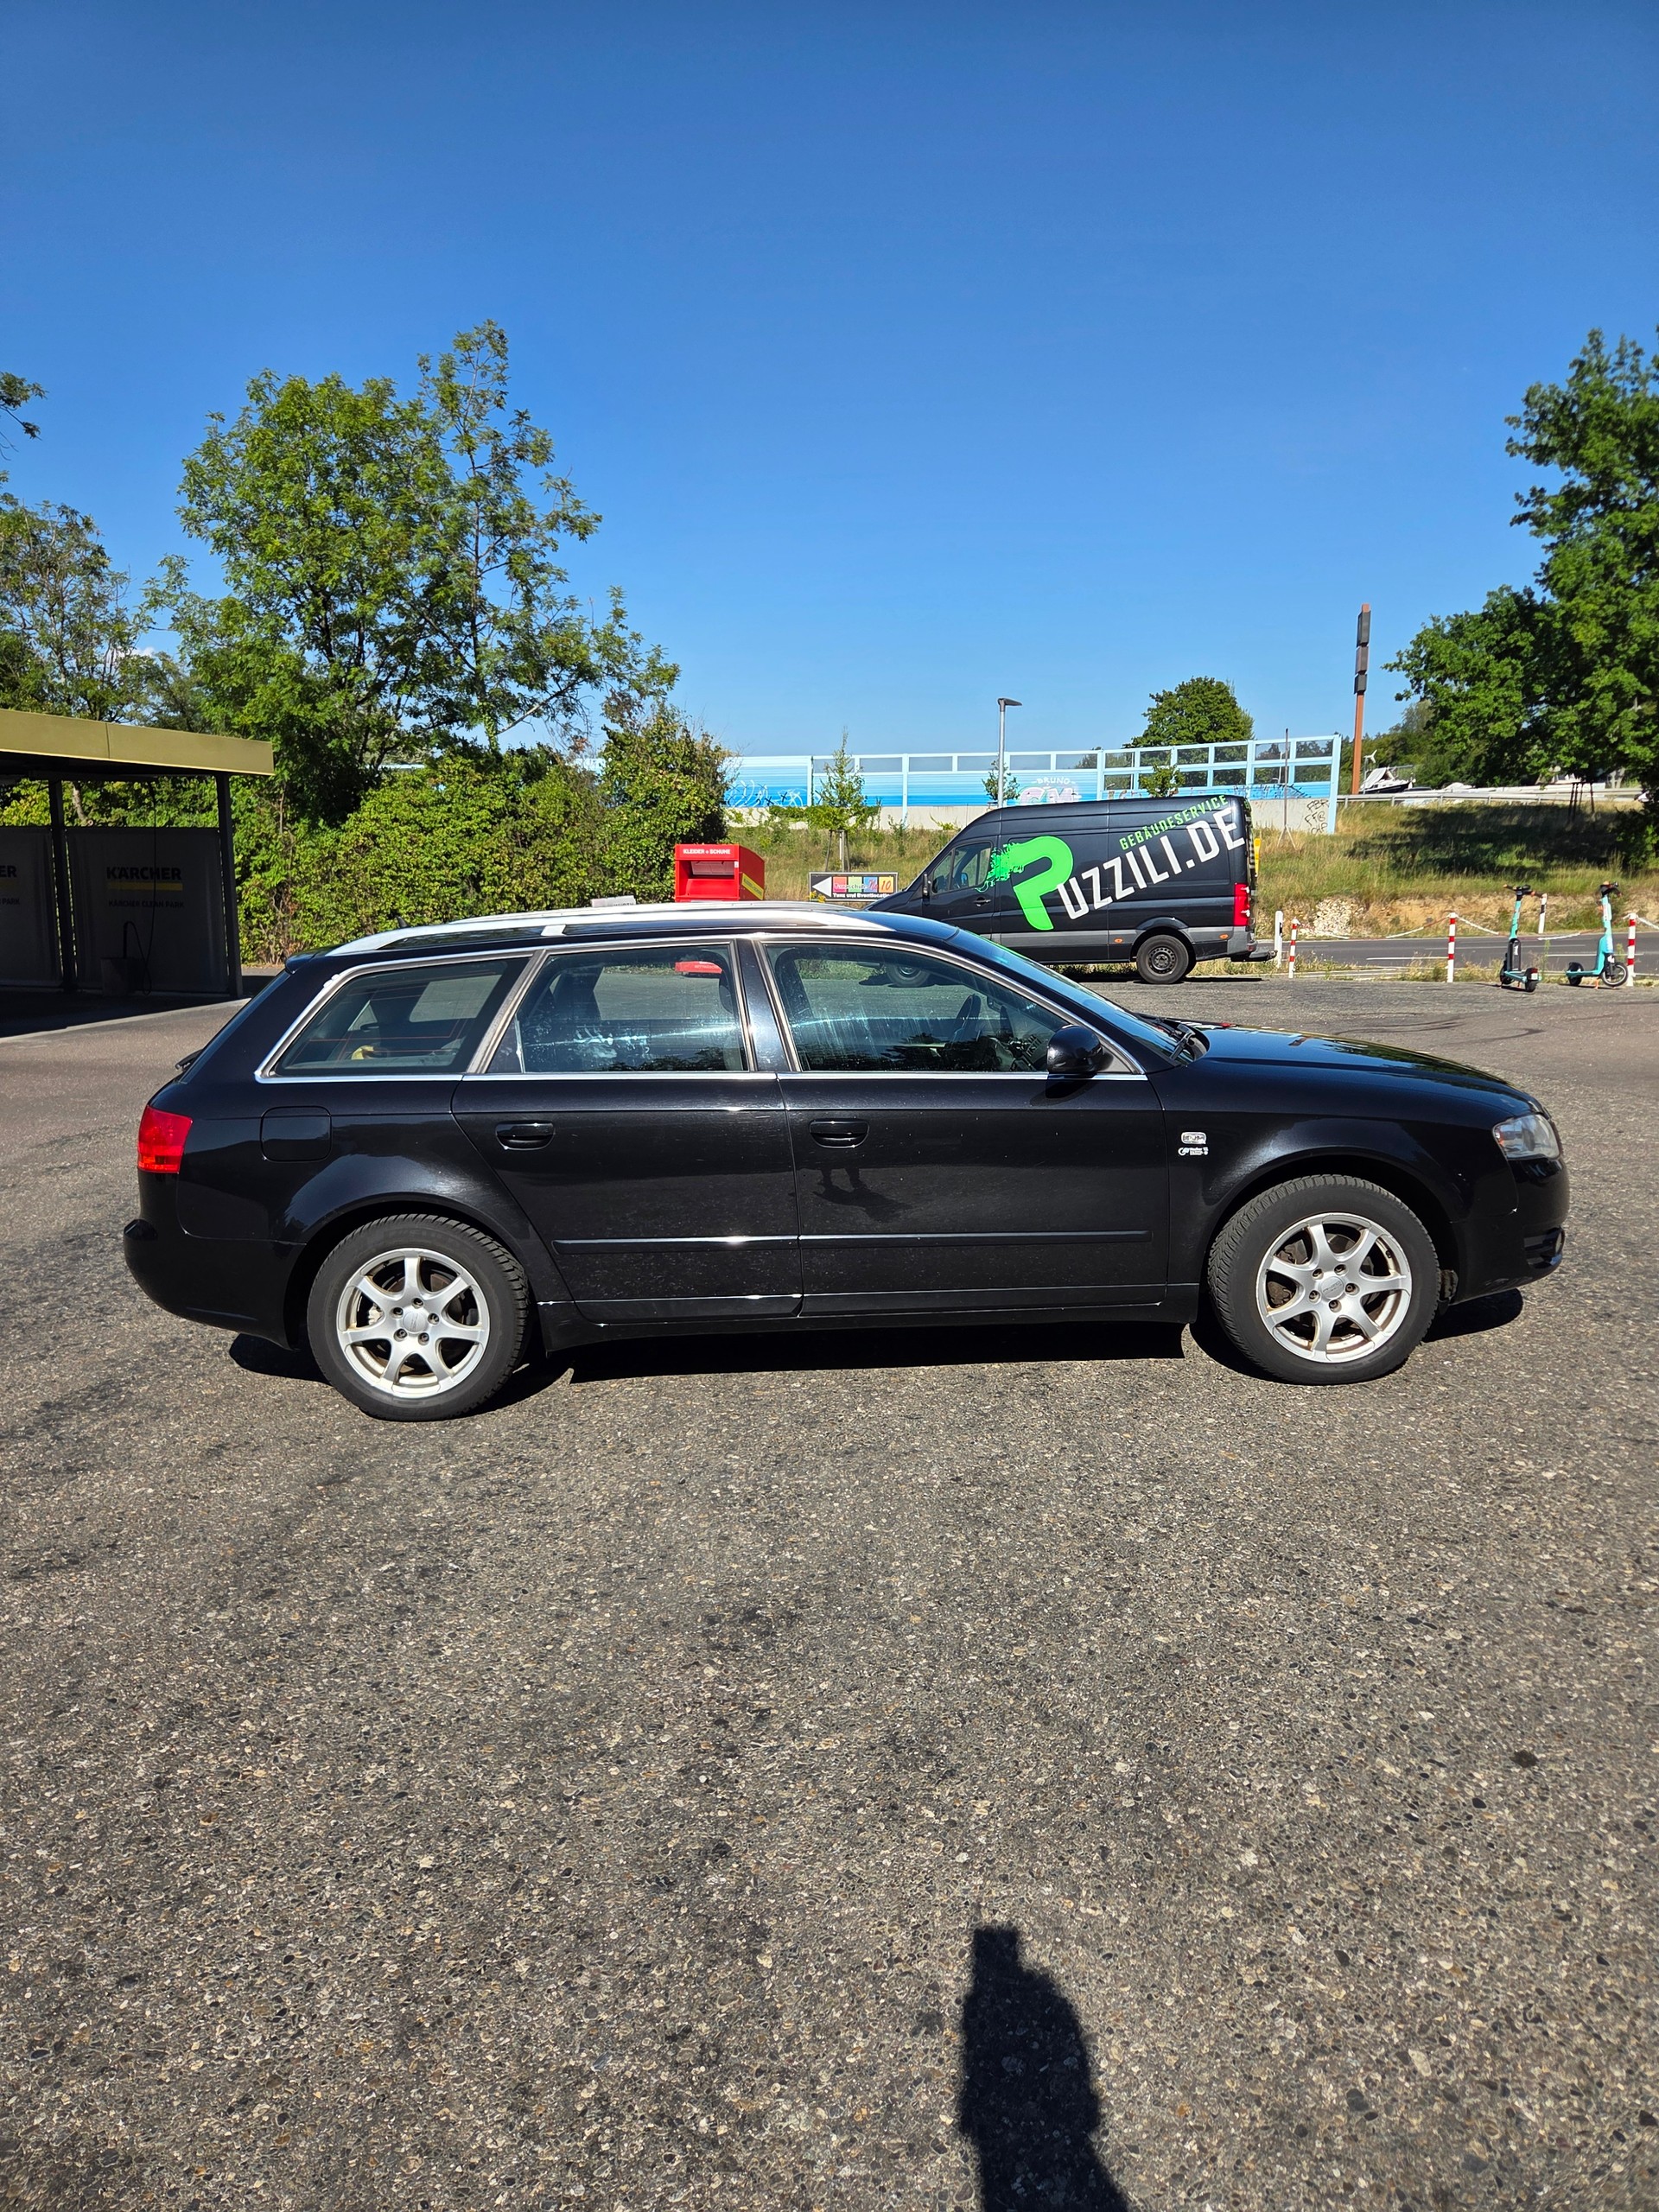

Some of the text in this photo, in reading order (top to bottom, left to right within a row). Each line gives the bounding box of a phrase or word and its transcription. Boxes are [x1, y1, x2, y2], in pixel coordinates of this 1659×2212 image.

[1119, 794, 1229, 850] GEBÄUDESERVICE
[106, 866, 181, 880] KÄRCHER
[881, 880, 892, 891] 10
